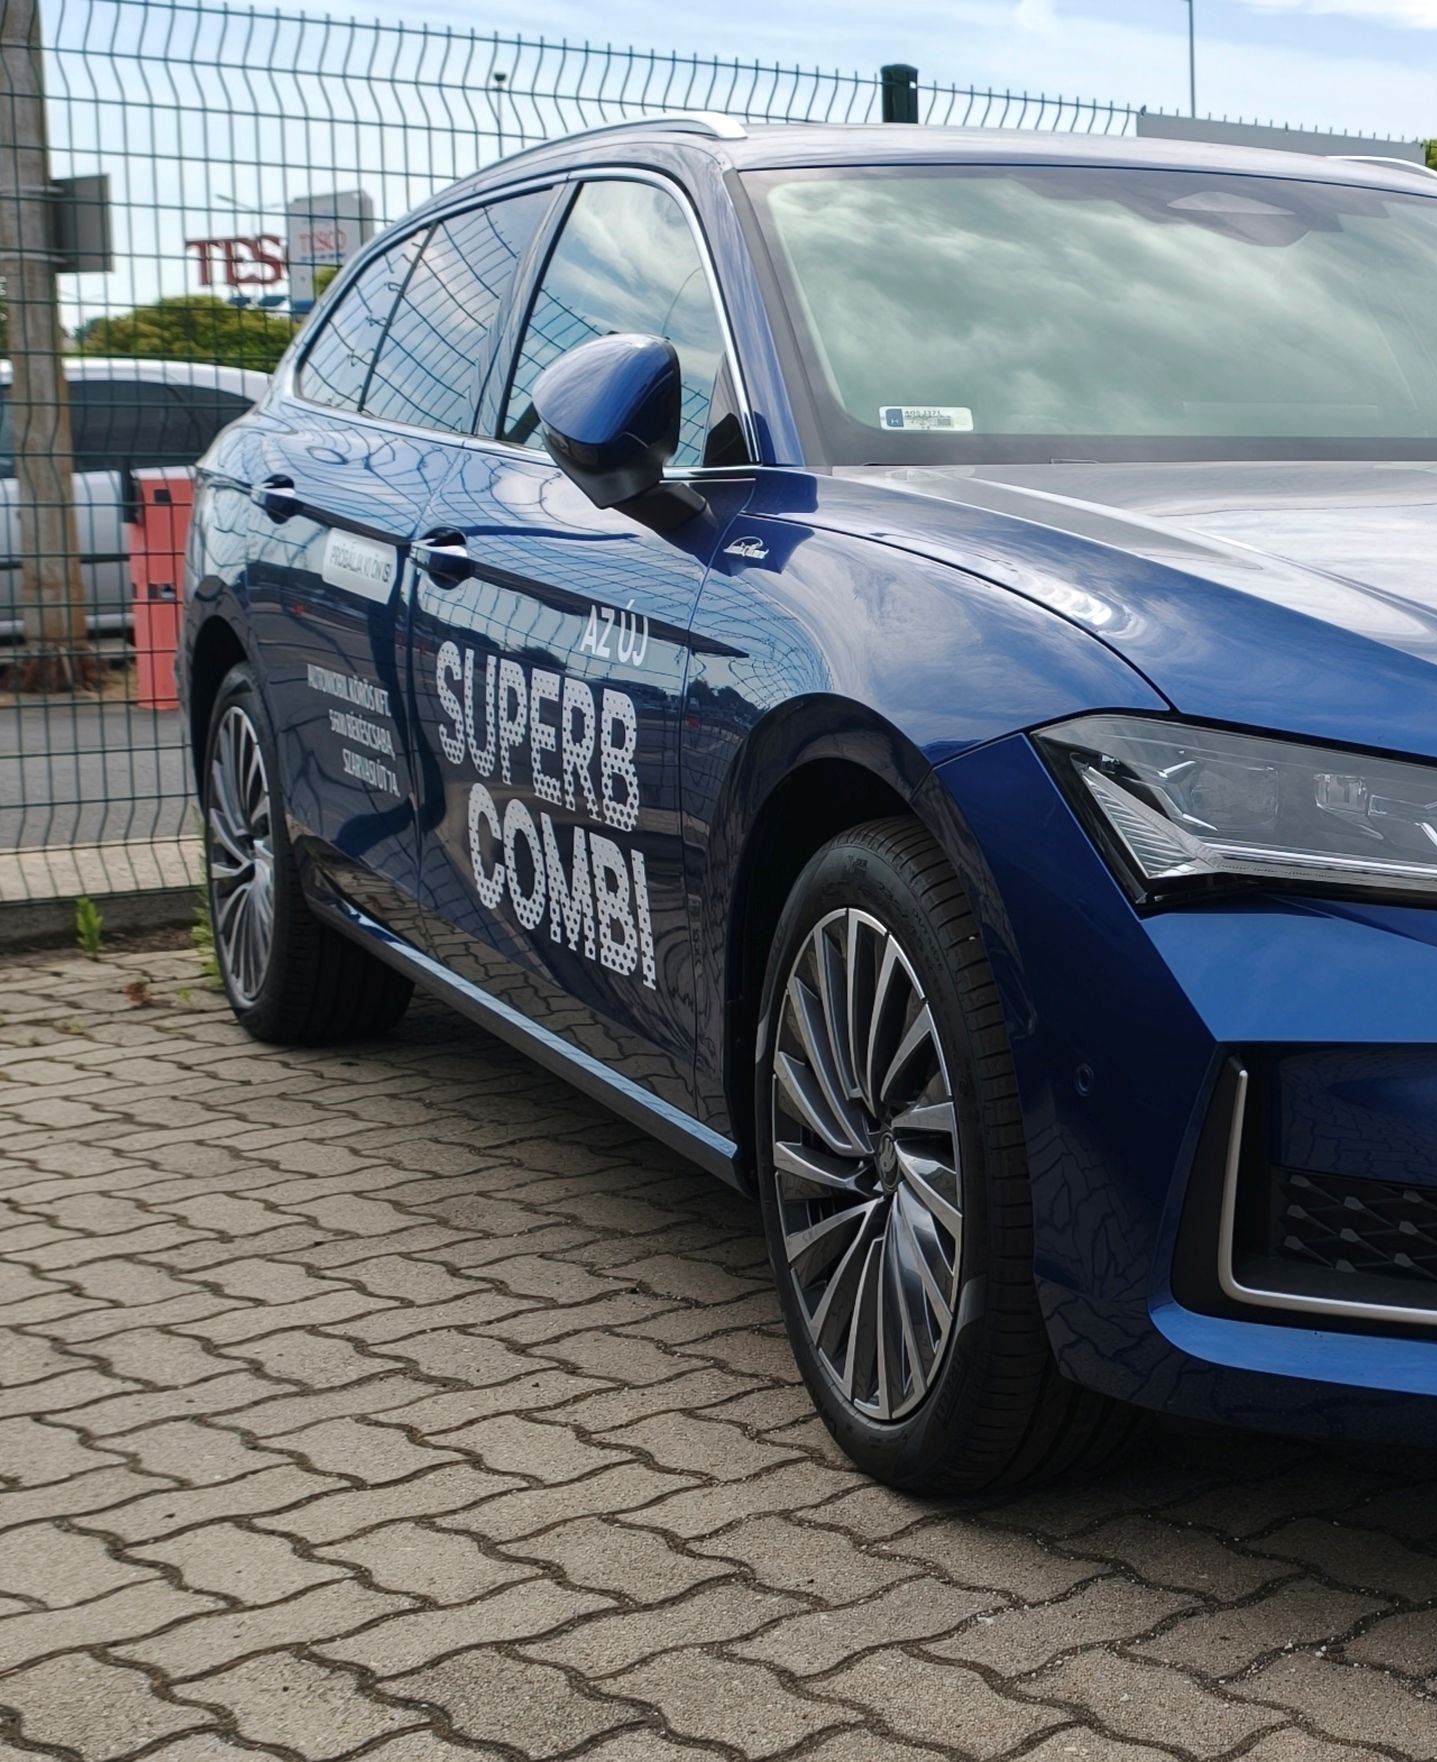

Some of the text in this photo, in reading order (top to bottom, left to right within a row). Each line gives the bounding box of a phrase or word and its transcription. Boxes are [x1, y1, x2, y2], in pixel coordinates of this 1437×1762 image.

[185, 234, 285, 286] TES
[580, 599, 649, 667] AZ ÚJ
[435, 640, 640, 833] SUPERB
[468, 781, 657, 991] COMBI
